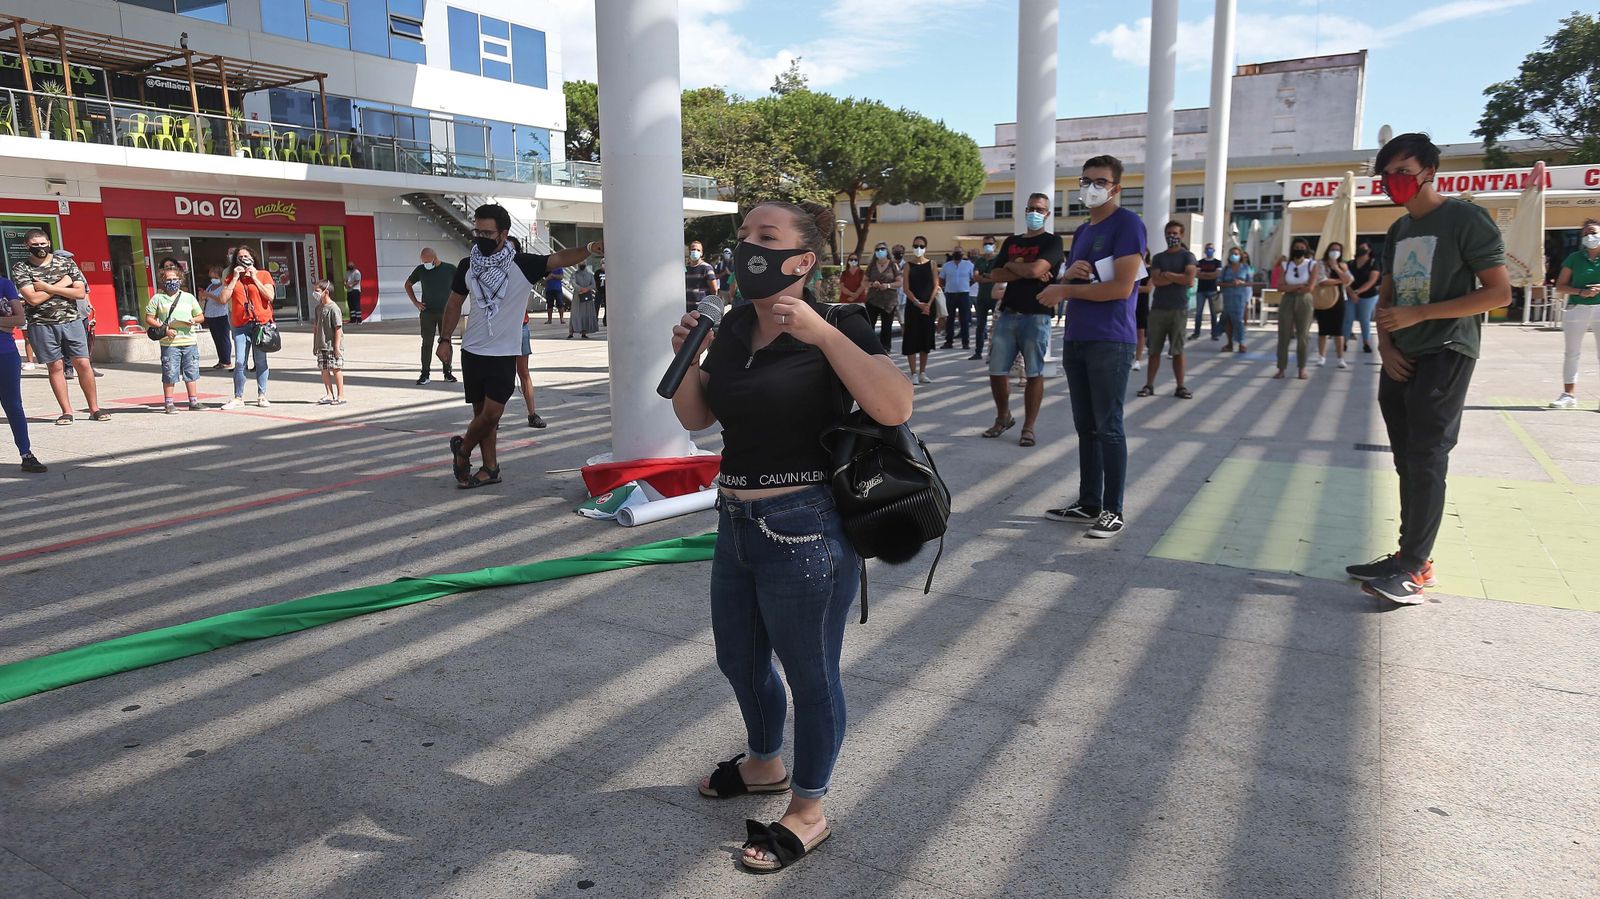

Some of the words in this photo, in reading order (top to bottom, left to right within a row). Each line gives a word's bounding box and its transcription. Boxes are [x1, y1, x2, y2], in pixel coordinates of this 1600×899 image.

[1301, 181, 1342, 197] CAF
[255, 201, 296, 217] market
[308, 246, 316, 285] CALIDAD
[760, 472, 799, 486] CALVIN
[800, 470, 827, 482] KLEIN
